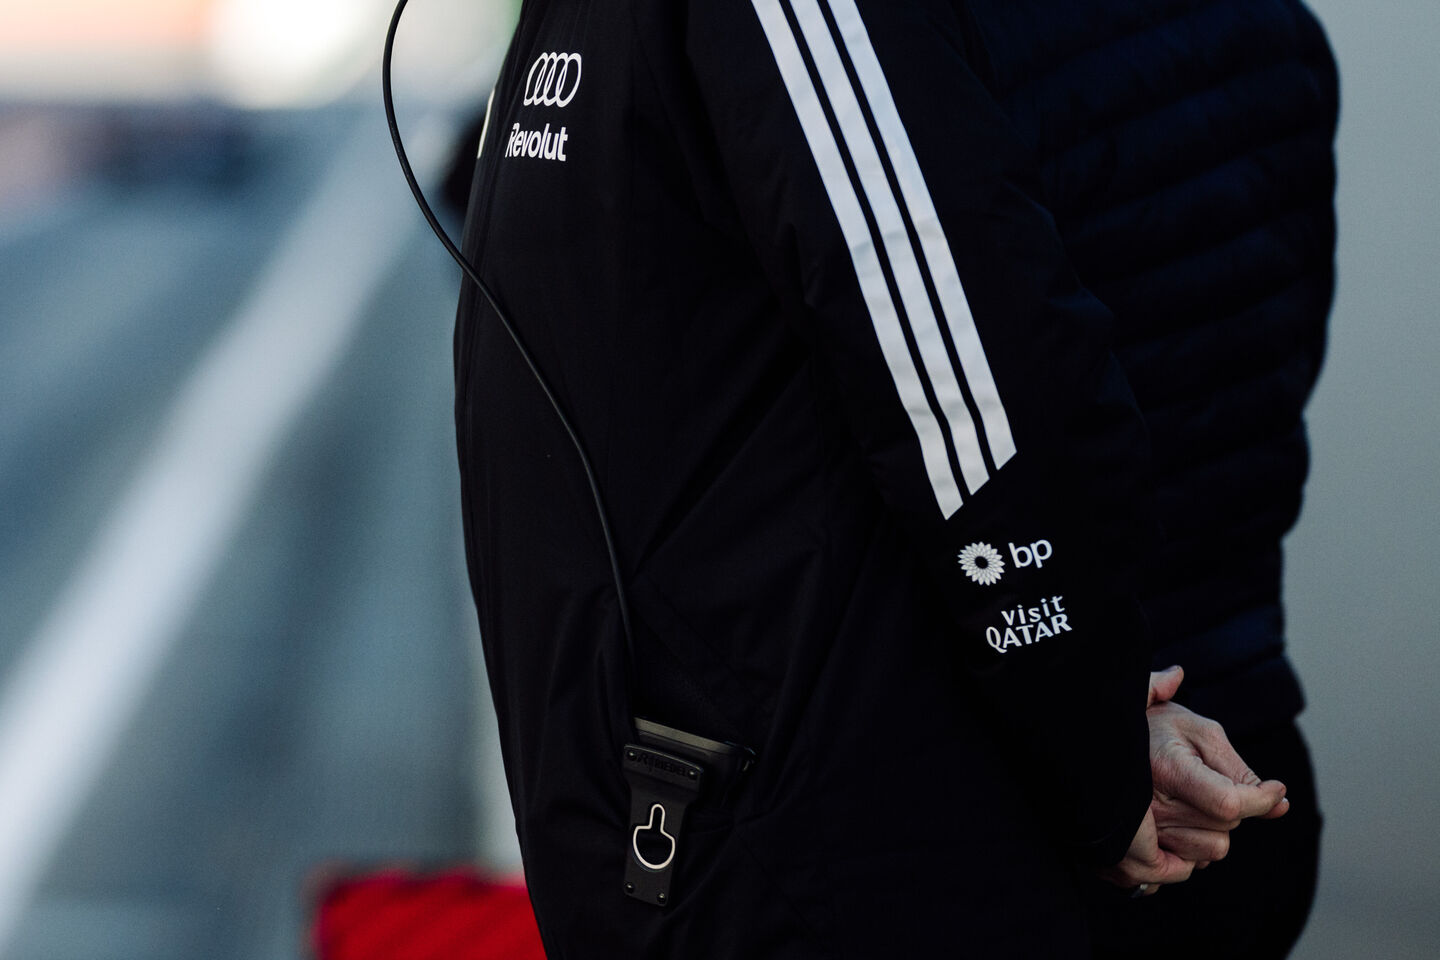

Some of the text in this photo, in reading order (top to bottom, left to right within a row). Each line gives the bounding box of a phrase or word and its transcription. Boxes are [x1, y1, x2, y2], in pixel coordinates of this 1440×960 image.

[505, 122, 569, 162] Revolut
[1008, 539, 1053, 569] bp
[1001, 595, 1066, 626] visit
[985, 613, 1073, 654] QATAR
